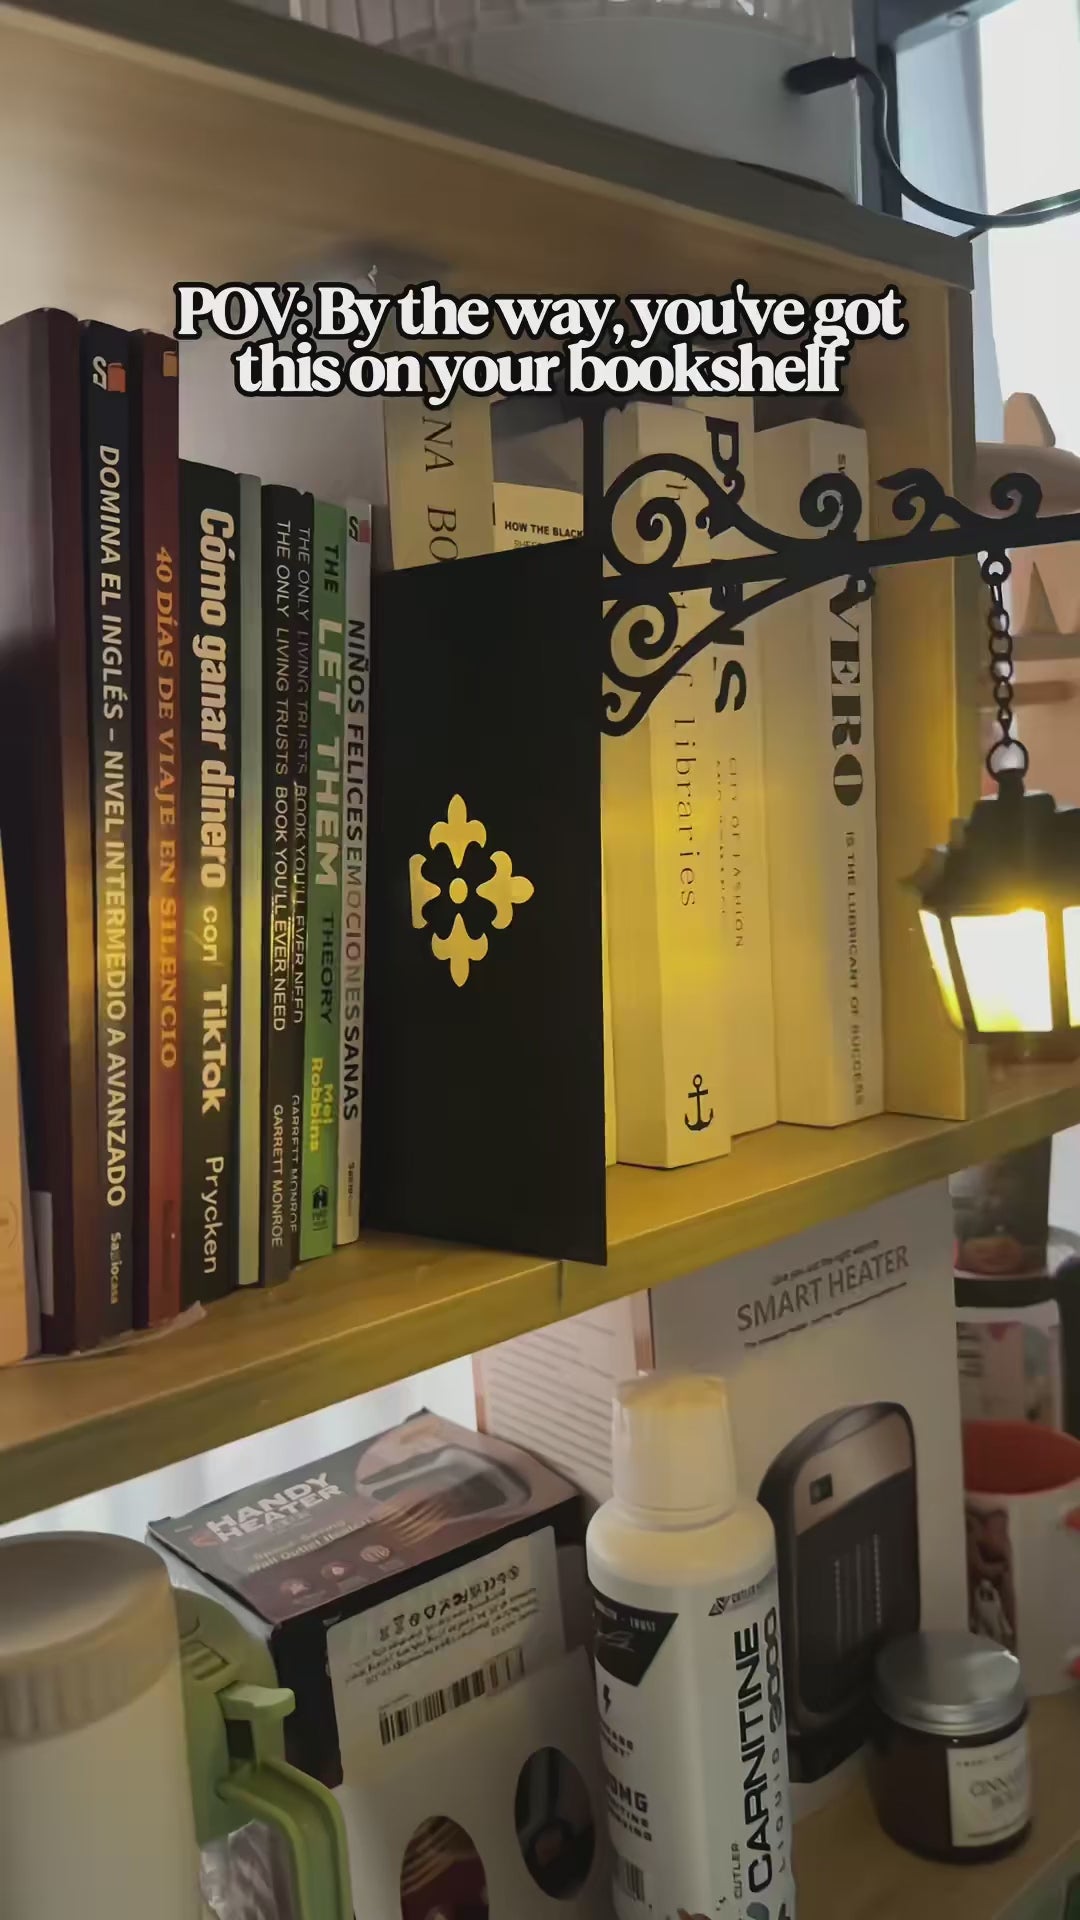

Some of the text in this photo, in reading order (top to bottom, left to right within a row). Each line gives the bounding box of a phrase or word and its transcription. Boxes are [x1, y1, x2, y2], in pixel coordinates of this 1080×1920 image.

[100, 445, 121, 564] DOMINA
[297, 527, 312, 565] THE
[504, 520, 584, 539] HOW THE BLACK
[101, 573, 121, 606] EL
[297, 570, 310, 621] ONLY
[102, 614, 128, 720] INGLÉS
[104, 750, 124, 833] NIVEL
[154, 546, 178, 1068] 40 DÍAS DE VIAJE EN SILENCIO
[192, 508, 235, 1114] Cómo ganar dinero con TikTok
[273, 520, 291, 1031] THE ONLY LIVING TRUSTS BOOK YOU'LL EVER NEED
[315, 545, 343, 1024] THE LET THEM THEORY
[674, 718, 700, 907] libraries
[343, 620, 369, 1121] NIÑOS FELICES EMOCIONES SANAS
[847, 852, 858, 887] THE
[105, 841, 127, 1020] INTERMEDIO
[107, 1027, 126, 1047] A
[107, 1052, 126, 1207] AVANZADO
[309, 1057, 324, 1153] Robbins
[201, 1156, 225, 1274] Prycken
[270, 1104, 285, 1248] GARRETT MONROE
[737, 1276, 823, 1332] SMART
[828, 1245, 910, 1298] HEATER
[206, 1472, 329, 1532] HANDY
[216, 1484, 347, 1543] HEATER
[734, 1622, 773, 1894] CARNITINE
[772, 1747, 787, 1873] LIQUID
[731, 1842, 741, 1899] CUTLER
